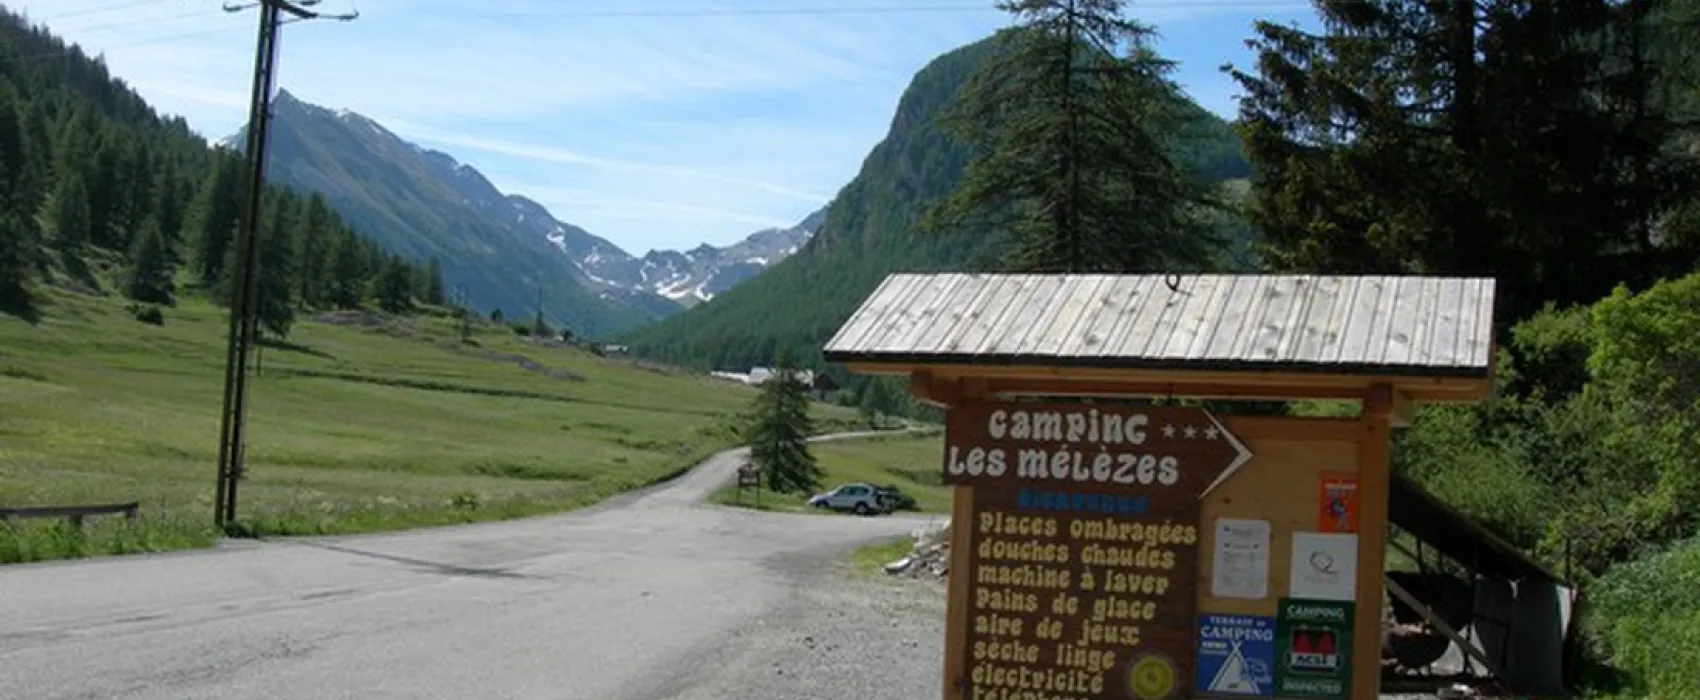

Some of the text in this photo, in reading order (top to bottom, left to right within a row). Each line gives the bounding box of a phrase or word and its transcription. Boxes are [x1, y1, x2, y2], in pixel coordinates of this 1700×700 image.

[979, 512, 1197, 547] Places ombragées
[978, 538, 1176, 569] douches chaudes
[977, 564, 1170, 595] machine à laver
[976, 588, 1157, 621] Pains de glace
[974, 613, 1141, 646] aire de jeux
[1201, 624, 1274, 643] CAMPING
[973, 636, 1115, 671] sèche linge
[971, 661, 1104, 694] électricité
